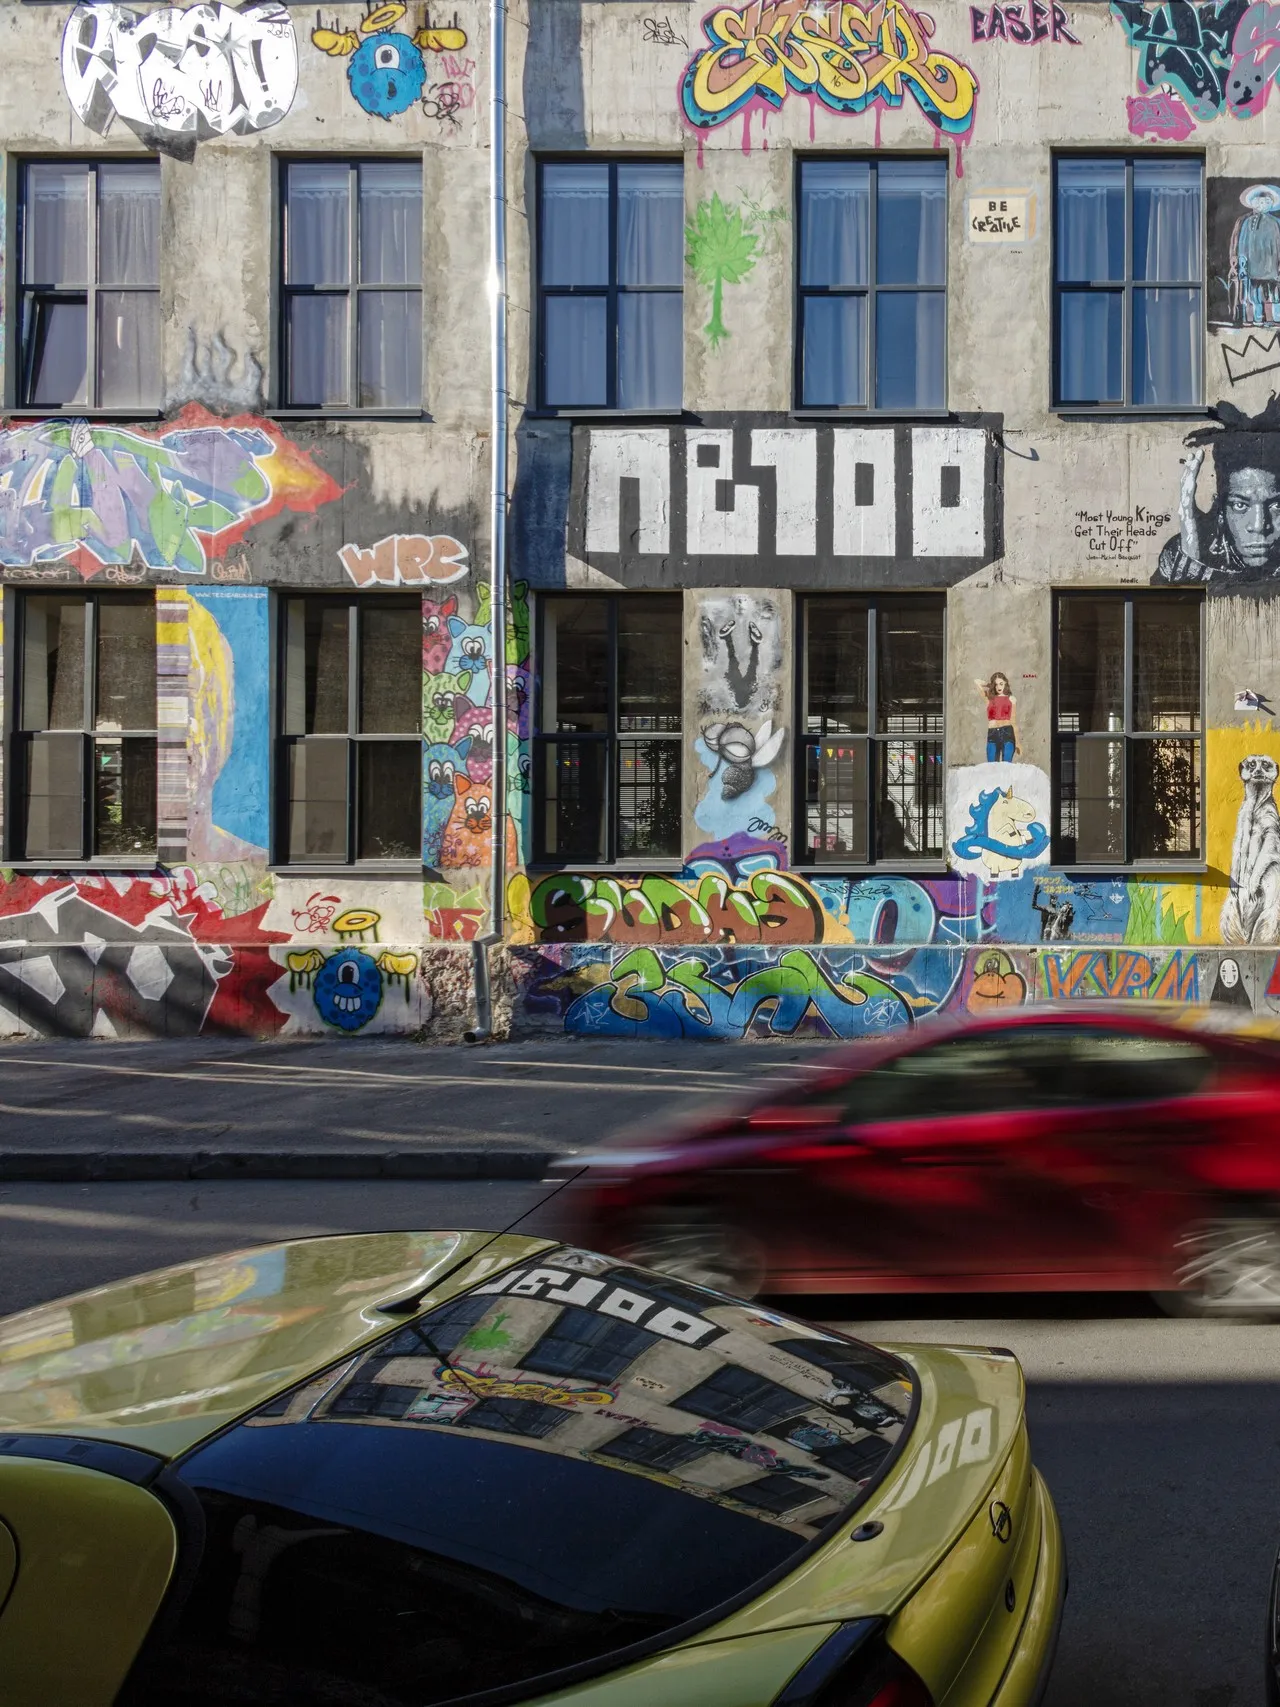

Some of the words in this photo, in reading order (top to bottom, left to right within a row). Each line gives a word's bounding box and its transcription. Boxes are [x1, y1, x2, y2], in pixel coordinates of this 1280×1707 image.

[970, 2, 1080, 45] EASER
[972, 216, 1021, 233] CREATIVE
[1106, 510, 1133, 525] Young
[1135, 505, 1172, 527] Kings
[1074, 525, 1093, 537] Get
[1096, 525, 1123, 537] Their
[1126, 524, 1157, 537] Heads
[1089, 538, 1106, 550] Cut
